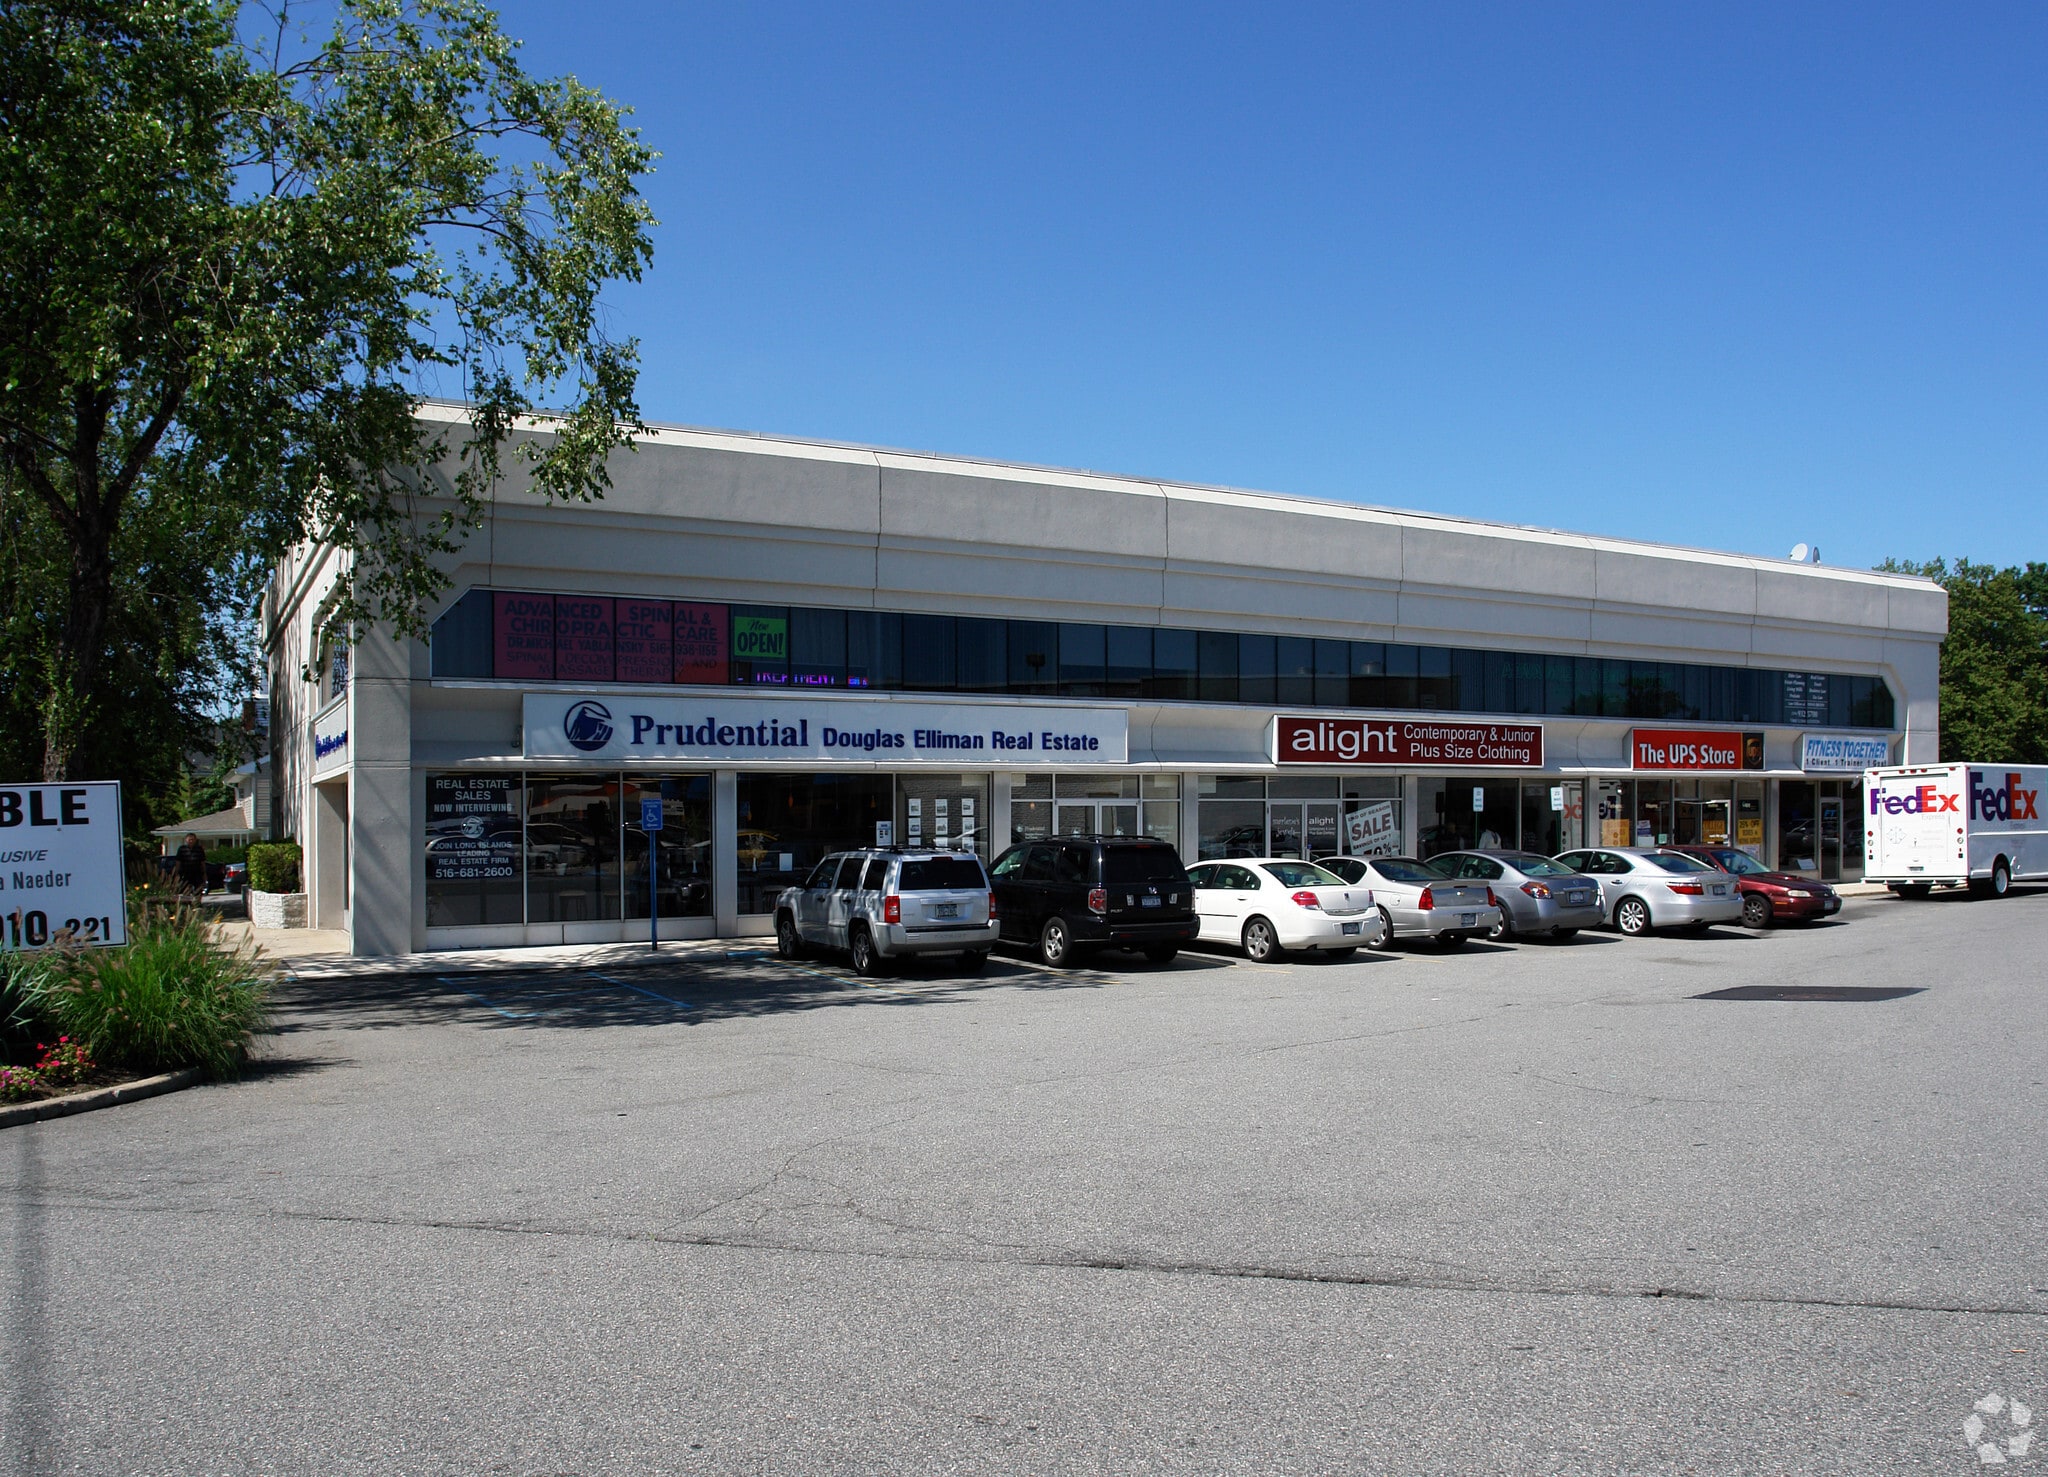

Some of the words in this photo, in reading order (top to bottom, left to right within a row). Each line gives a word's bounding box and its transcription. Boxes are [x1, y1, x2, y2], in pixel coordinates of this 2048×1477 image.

[504, 600, 602, 620] ADVANCED
[629, 606, 697, 625] SPINAL
[702, 612, 712, 625] &
[510, 617, 656, 638] CHIROPRACTIC
[675, 626, 718, 641] CARE
[737, 631, 784, 654] OPEN!
[507, 652, 552, 663] SPINAL
[692, 659, 717, 668] AND
[630, 715, 809, 747] Prudential
[823, 728, 905, 751] Douglas
[914, 729, 984, 749] Elliman
[992, 731, 1033, 750] Real
[1041, 732, 1099, 750] Estate
[1291, 722, 1398, 760] alight
[1403, 724, 1487, 744] Contemporary
[1490, 727, 1498, 741] &
[1501, 728, 1535, 742] Junior
[1410, 743, 1440, 758] Plus
[1444, 743, 1474, 759] Size
[1477, 744, 1530, 763] Clothing
[1639, 743, 1665, 763] The
[1669, 743, 1697, 764] UPS
[1700, 744, 1735, 765] Store
[1806, 739, 1842, 757] FITNESS
[1843, 741, 1887, 758] TOGETHER
[1811, 758, 1830, 766] Client
[1841, 759, 1863, 767] Trainer
[436, 779, 465, 789] REAL
[469, 779, 510, 789] ESTATE
[455, 790, 491, 800] SALES
[1870, 785, 1960, 815] FedEx
[1970, 772, 2039, 822] FedEx
[434, 803, 453, 812] NOW
[455, 803, 512, 812] INTERVIEWING
[1308, 817, 1334, 826] alight
[1351, 812, 1391, 841] SALE
[461, 857, 489, 865] ESTATE
[13, 870, 72, 890] Naeder
[435, 867, 513, 878] 516-681-2600
